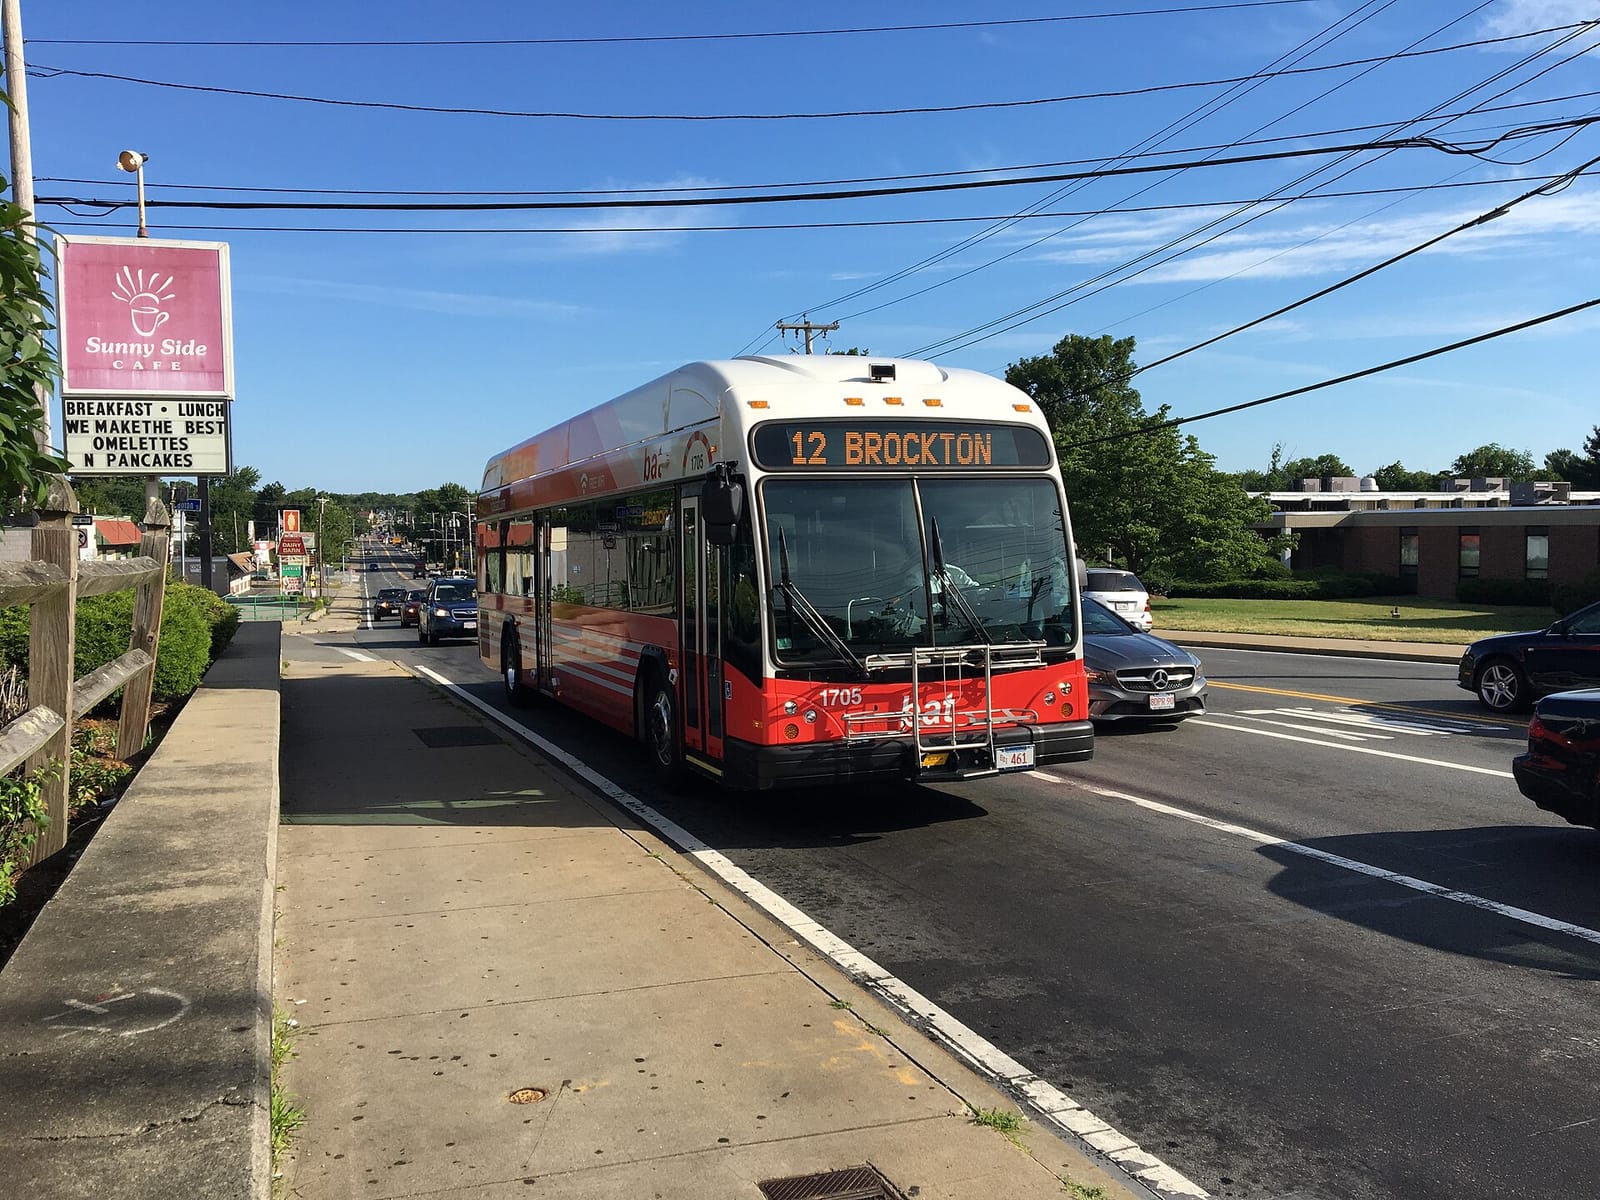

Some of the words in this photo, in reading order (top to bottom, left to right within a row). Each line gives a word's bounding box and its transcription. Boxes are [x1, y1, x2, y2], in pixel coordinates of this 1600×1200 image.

[85, 336, 155, 358] Sunny
[160, 338, 208, 357] Side
[112, 360, 182, 371] CAFE
[66, 401, 153, 416] BREAKFAST
[178, 403, 224, 417] LUNCH
[66, 420, 90, 434] WE
[185, 420, 225, 435] BEST
[93, 436, 189, 451] OMELETTES
[791, 431, 828, 465] 12
[845, 432, 992, 465] BROCKTON
[84, 453, 94, 467] N
[107, 453, 193, 467] PANCAKES
[643, 446, 664, 481] bat
[691, 453, 704, 471] 1705
[819, 687, 863, 706] 1705
[900, 692, 956, 728] bat
[1011, 752, 1028, 765] 461
